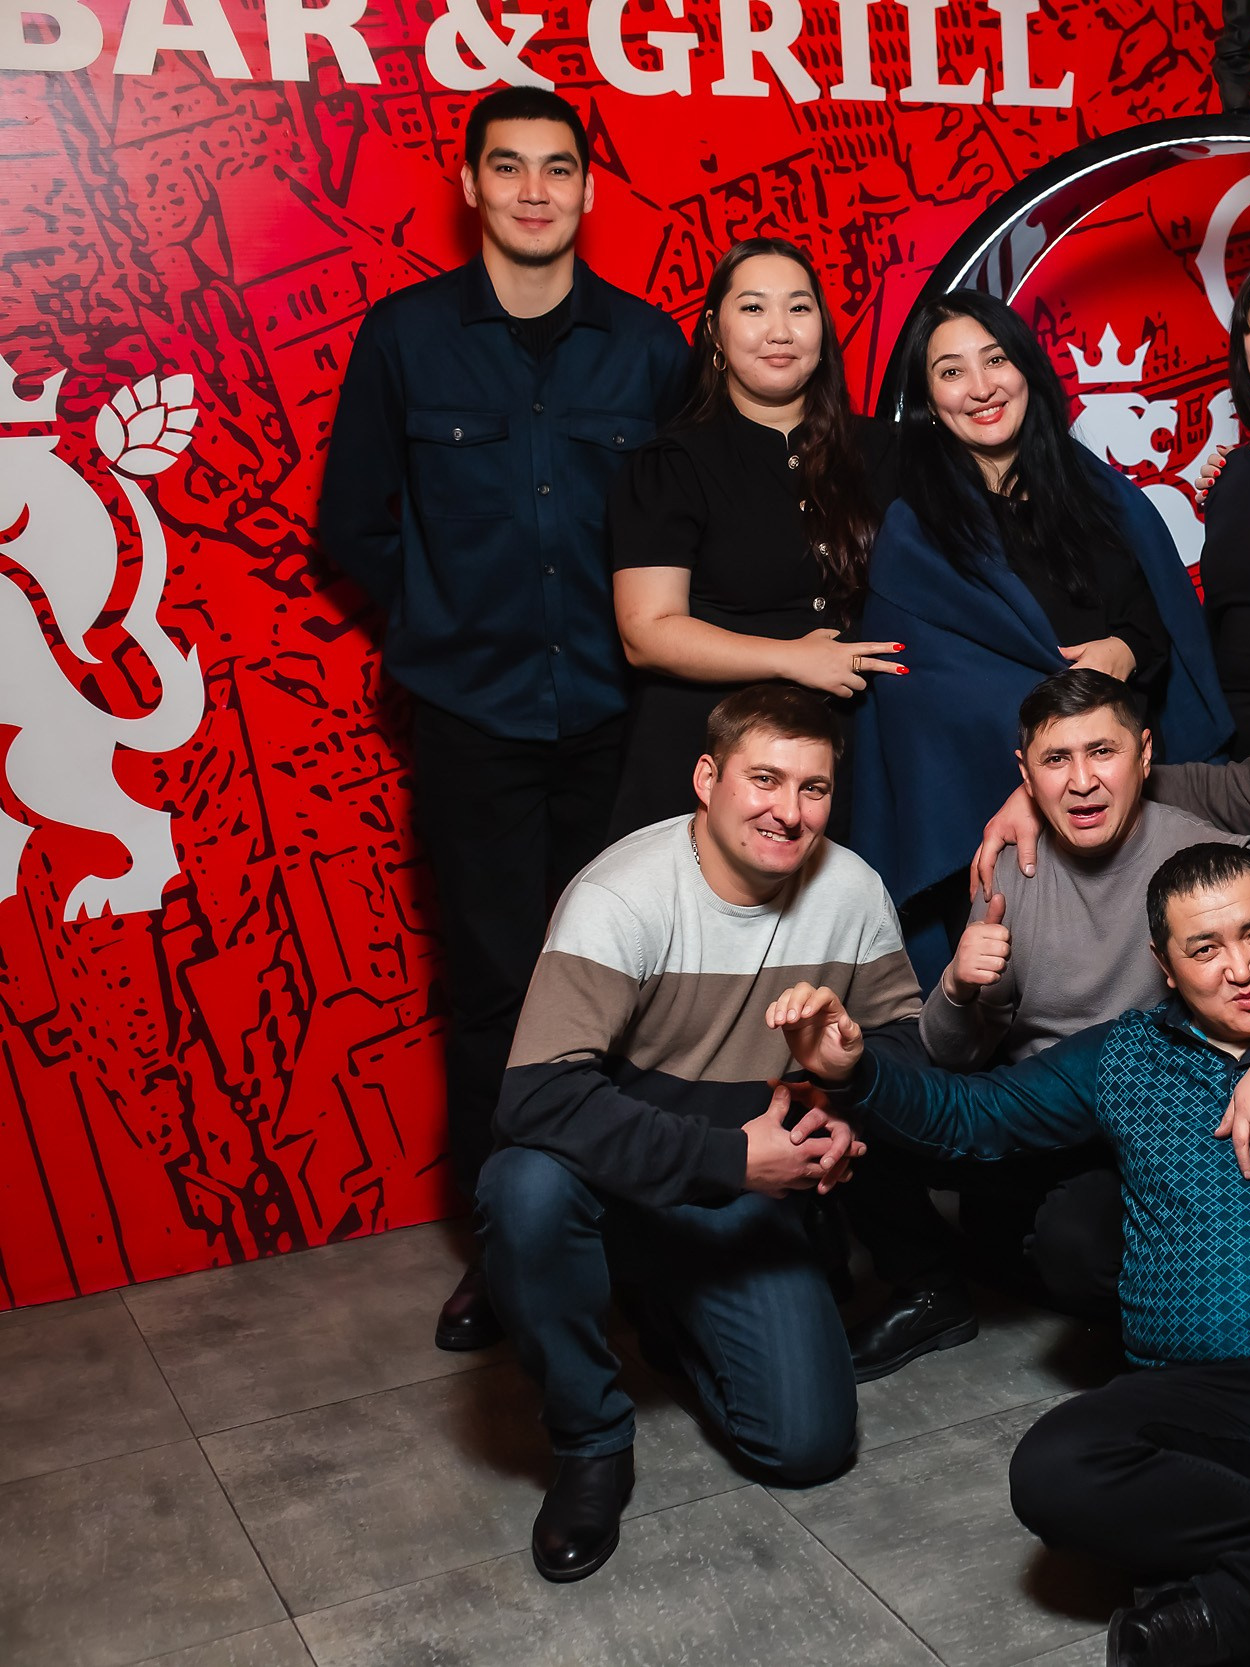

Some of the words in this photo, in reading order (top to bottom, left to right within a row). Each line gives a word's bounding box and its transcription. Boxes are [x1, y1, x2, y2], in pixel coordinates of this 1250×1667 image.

[0, 0, 382, 85] BAR
[425, 0, 556, 91] &
[587, 0, 1075, 108] GRILL
